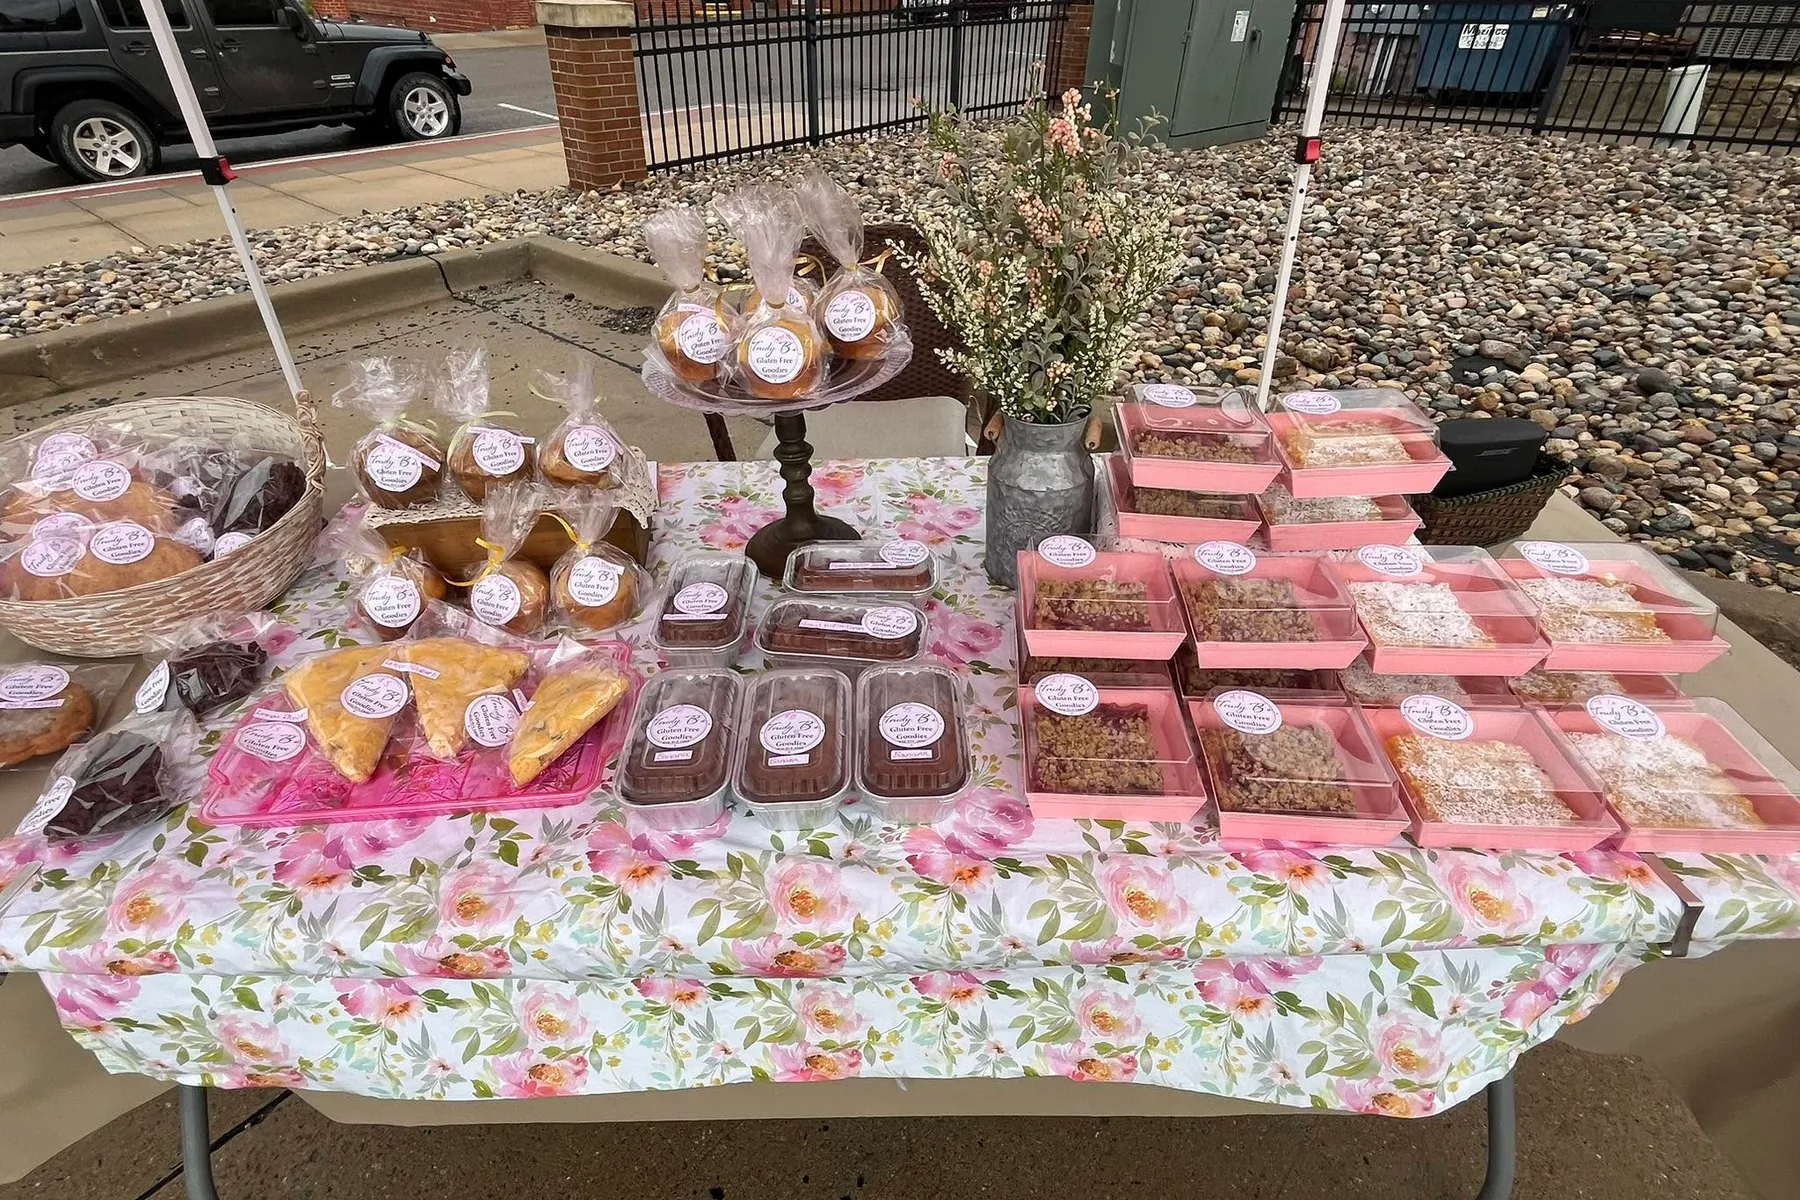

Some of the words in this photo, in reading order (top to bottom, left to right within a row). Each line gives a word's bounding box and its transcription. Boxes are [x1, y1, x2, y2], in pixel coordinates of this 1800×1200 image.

[752, 340, 775, 358] Trudy
[572, 568, 593, 583] Trudy
[574, 581, 595, 589] Gluten
[597, 583, 609, 591] Free
[654, 715, 680, 728] Trudy
[884, 713, 911, 727] Trudy
[656, 727, 682, 735] Gluten
[767, 721, 794, 735] Trudy
